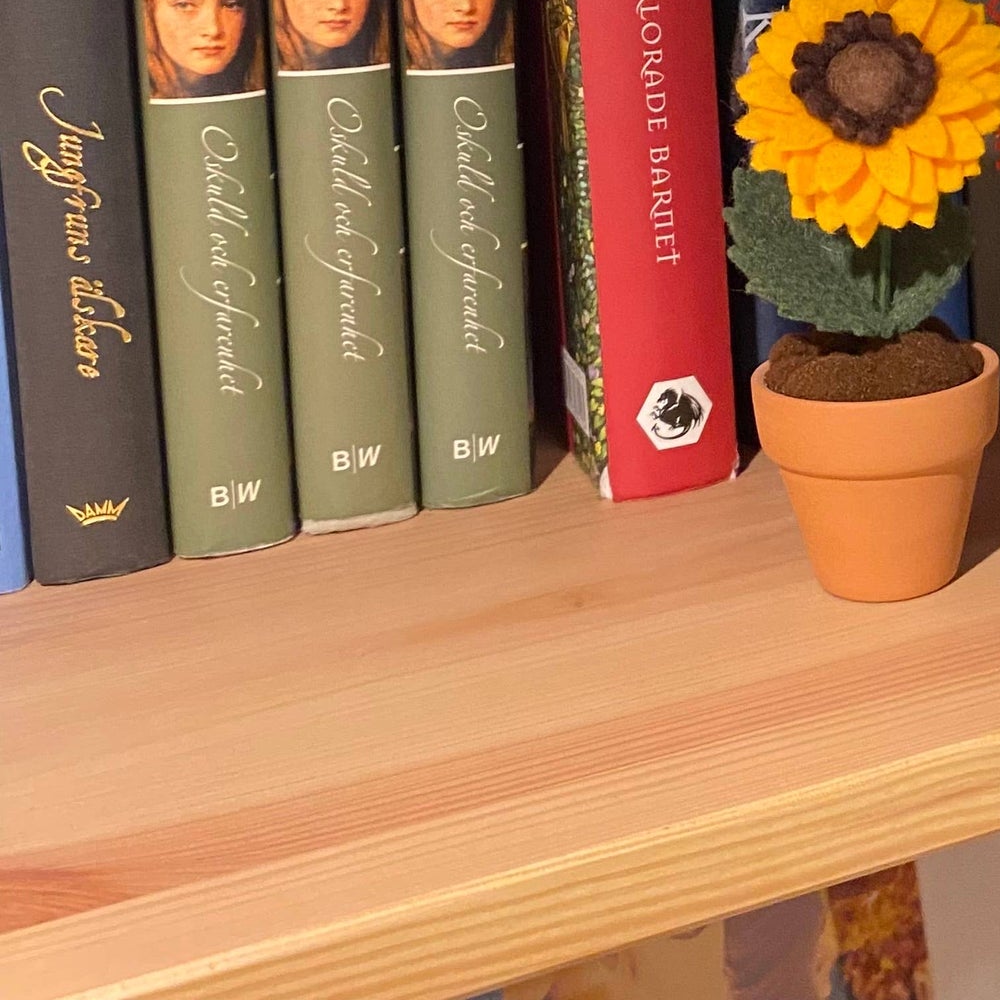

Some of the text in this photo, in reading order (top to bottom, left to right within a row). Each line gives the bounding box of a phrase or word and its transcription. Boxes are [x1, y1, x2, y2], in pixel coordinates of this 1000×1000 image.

[21, 86, 132, 379] Jungfruns älskare
[210, 233, 256, 287] och
[334, 202, 378, 256] och
[458, 198, 500, 250] och
[179, 265, 263, 395] erfarenhet
[304, 233, 385, 361] erfarenhet
[430, 228, 504, 354] erfarenhet
